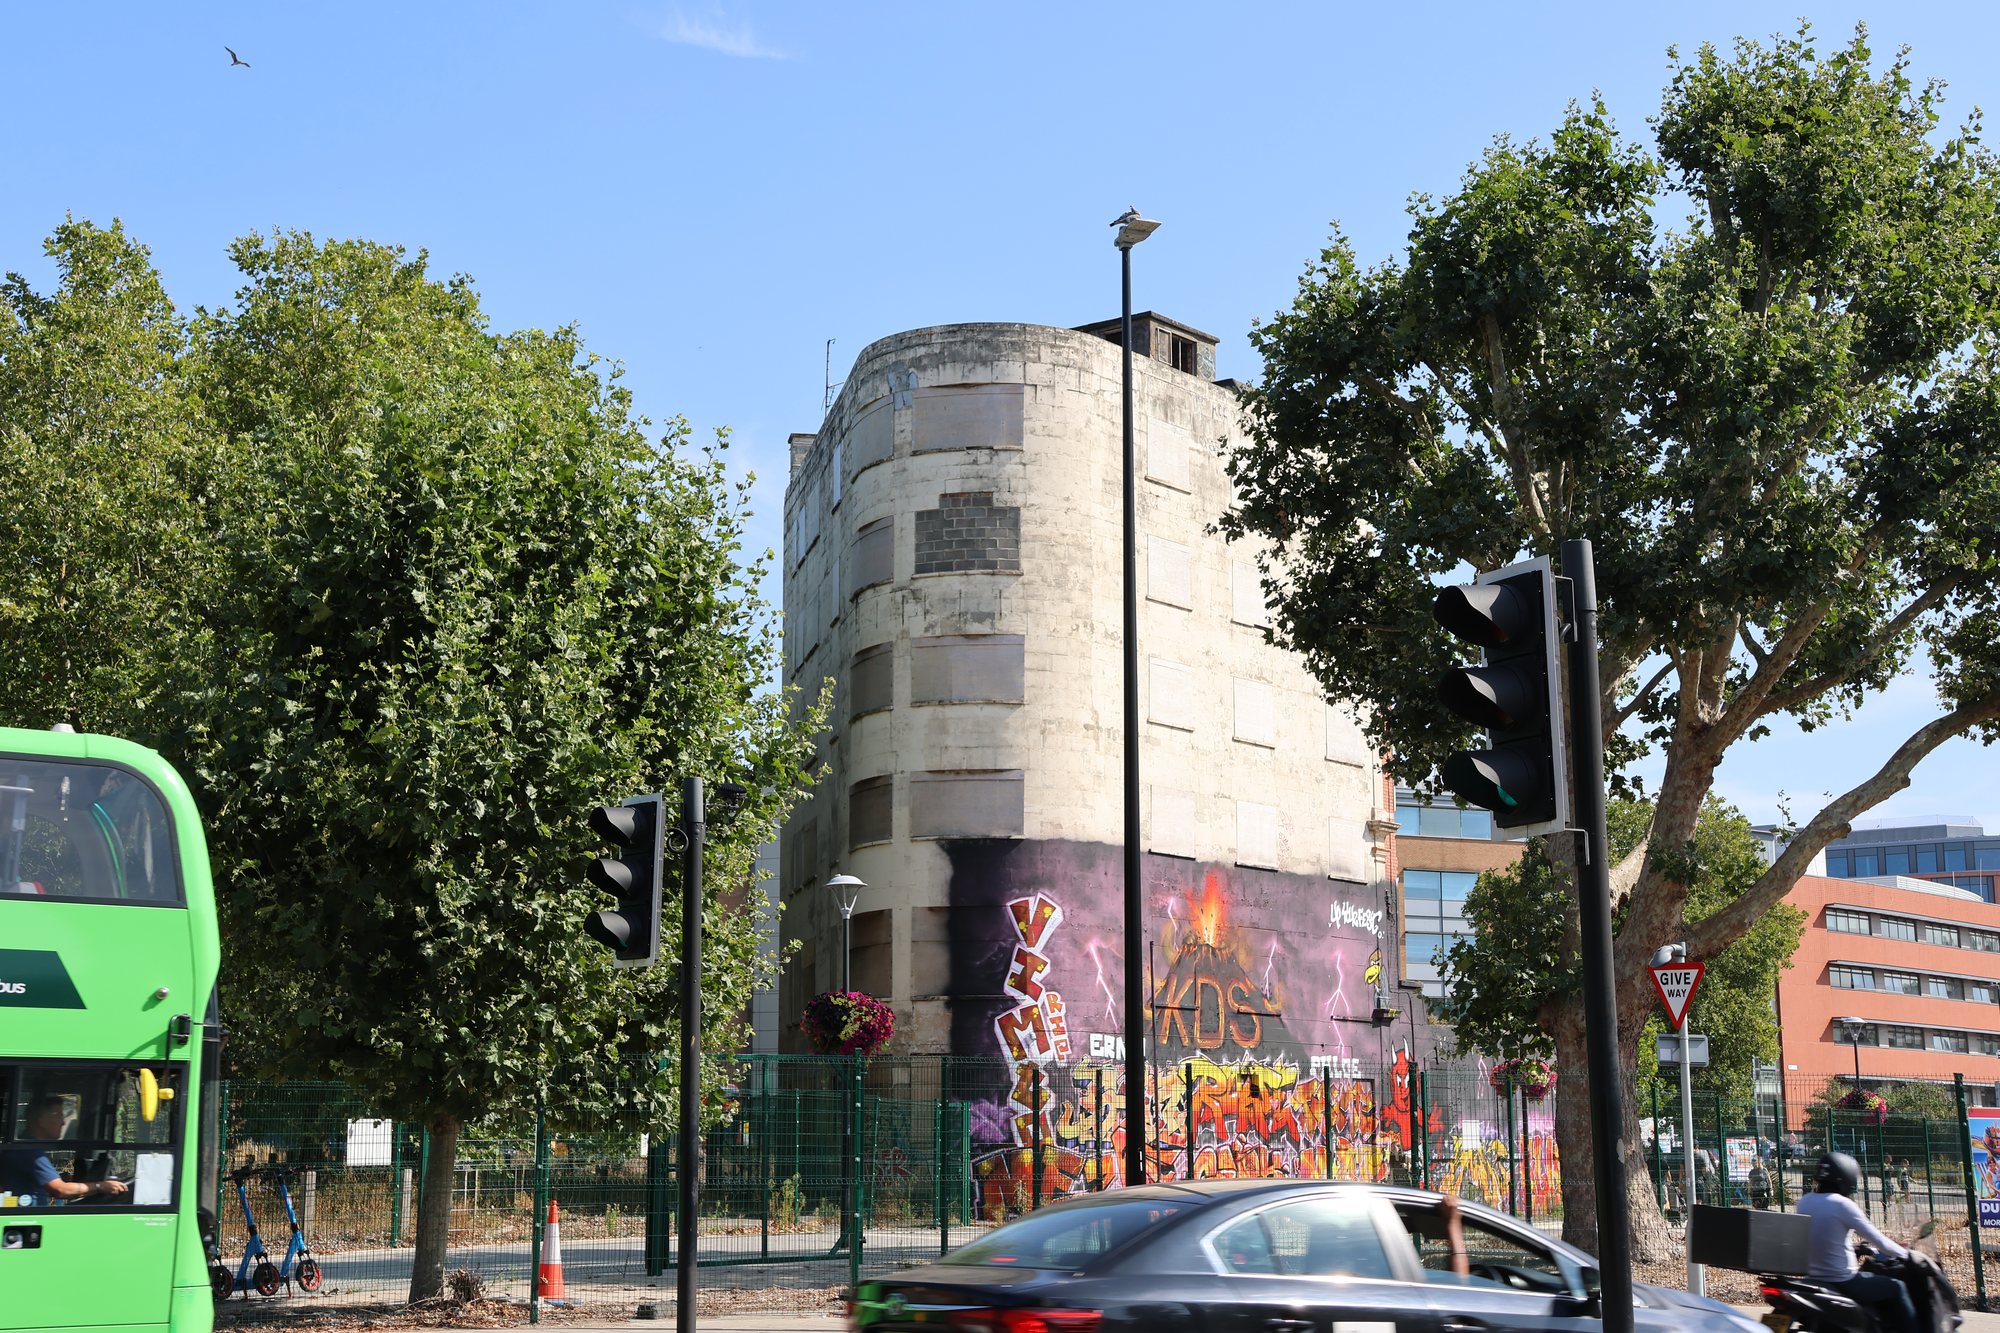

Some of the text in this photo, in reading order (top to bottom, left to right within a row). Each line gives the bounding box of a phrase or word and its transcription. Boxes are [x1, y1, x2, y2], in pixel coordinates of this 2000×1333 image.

[1660, 973, 1691, 985] GIVE
[1667, 989, 1687, 998] WAY
[1159, 975, 1261, 1049] KDS
[1090, 1033, 1146, 1061] ERN
